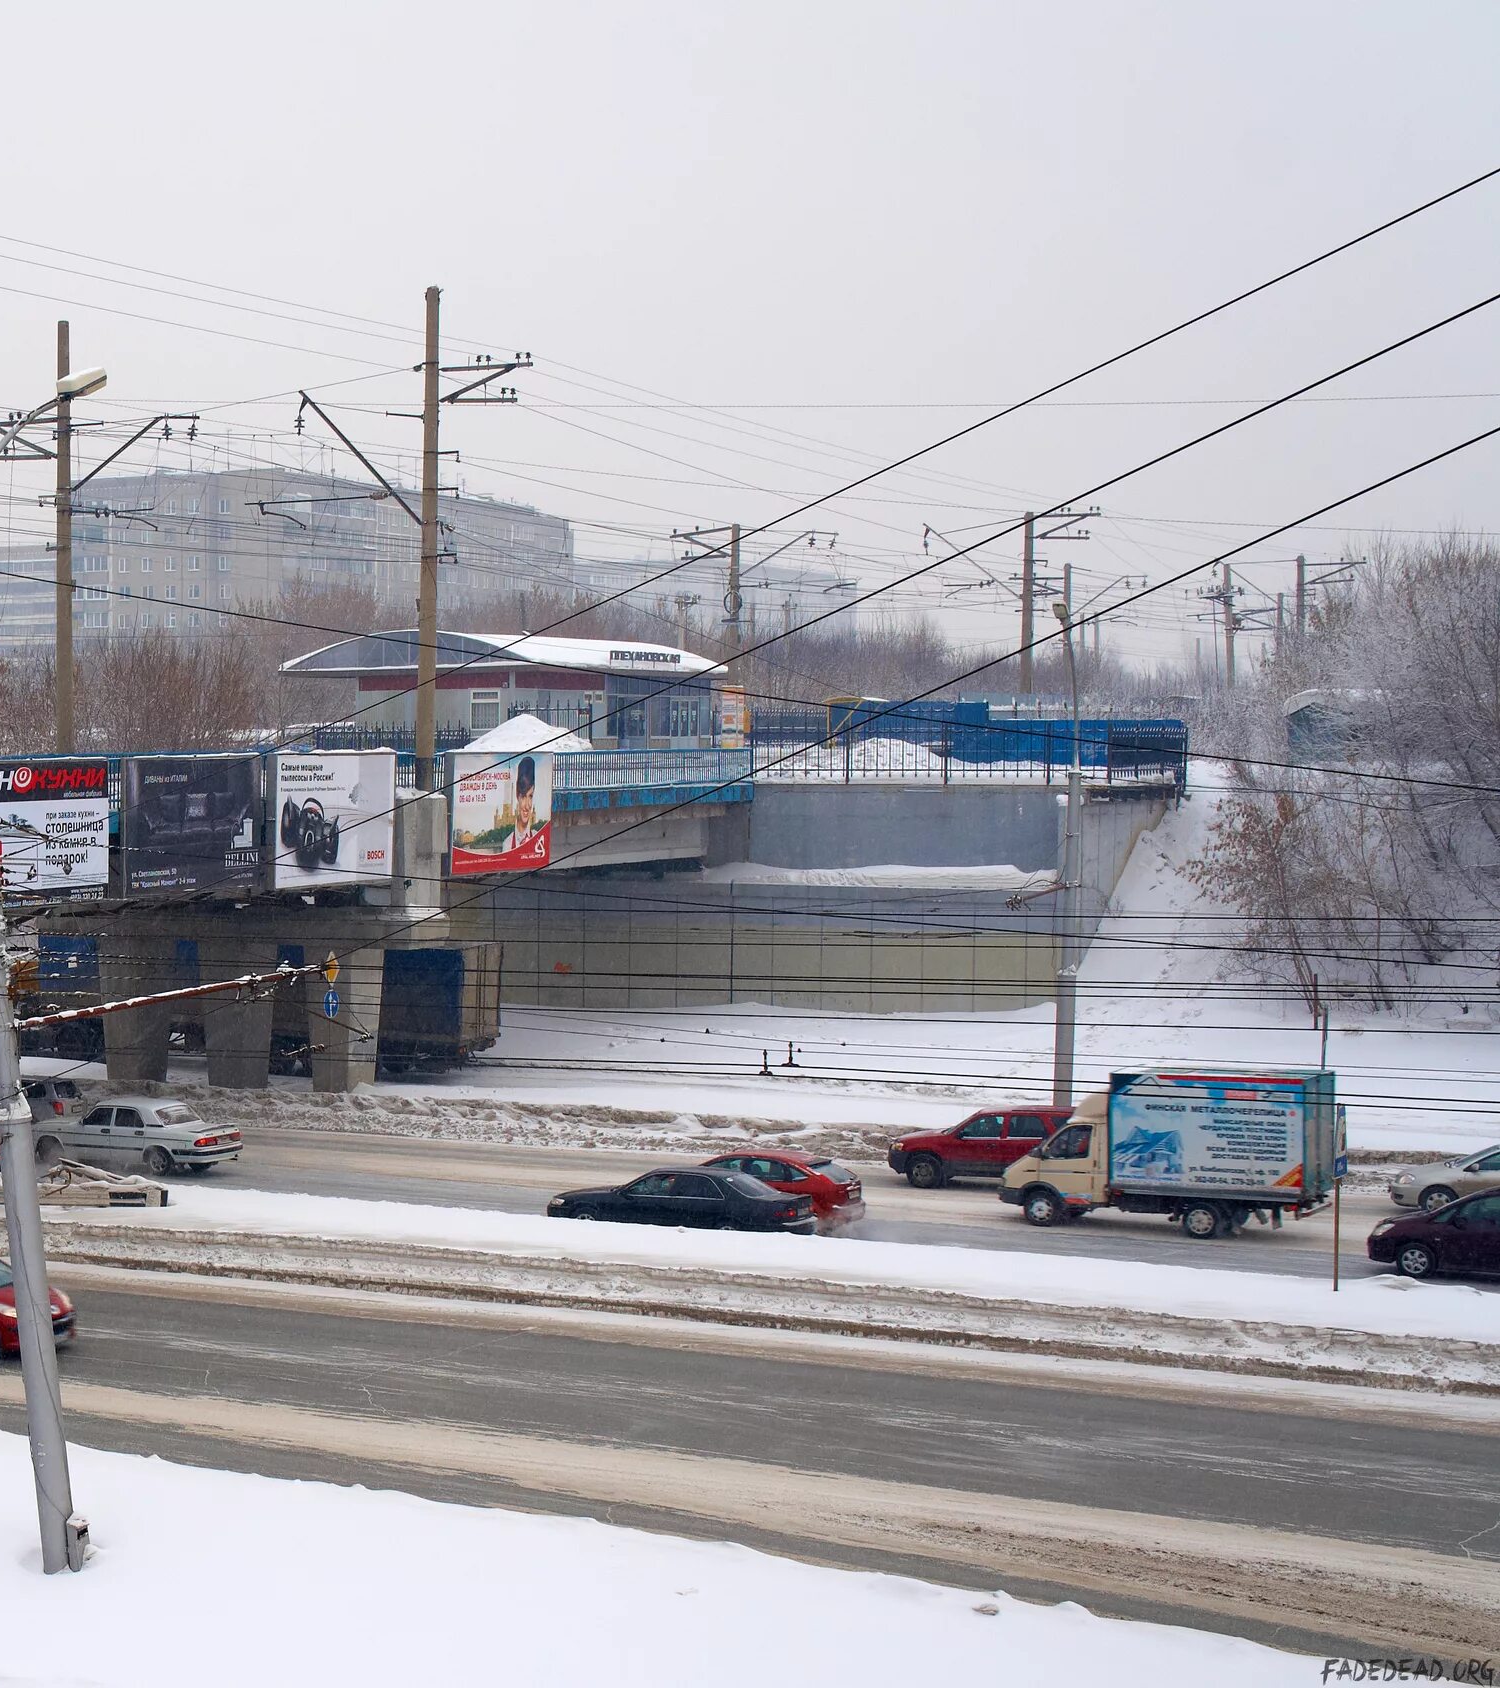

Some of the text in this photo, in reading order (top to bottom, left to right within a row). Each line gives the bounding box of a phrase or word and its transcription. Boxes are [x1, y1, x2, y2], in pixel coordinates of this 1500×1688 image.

[609, 650, 681, 664] ПЛЕХАНОВСКАЯ
[280, 762, 324, 773] Самые мощные
[144, 775, 164, 785] ДИВАНЫ
[170, 774, 188, 783] ИТАЛИИ
[280, 773, 308, 782] пылесосы
[459, 772, 511, 783] НОВОСИБИРСК-МОСКВА
[459, 783, 481, 792] ДВАЖДЫ
[485, 782, 498, 791] ДЕНЬ
[45, 811, 57, 821] при
[57, 811, 77, 819] заказе
[78, 810, 95, 820] кухни
[45, 820, 104, 834] столешница
[45, 849, 88, 867] подарок!
[367, 850, 385, 860] BOSCH
[1144, 1104, 1287, 1118] ФИНСКАЯ МЕТАЛЛОЧЕРЕПИЦА
